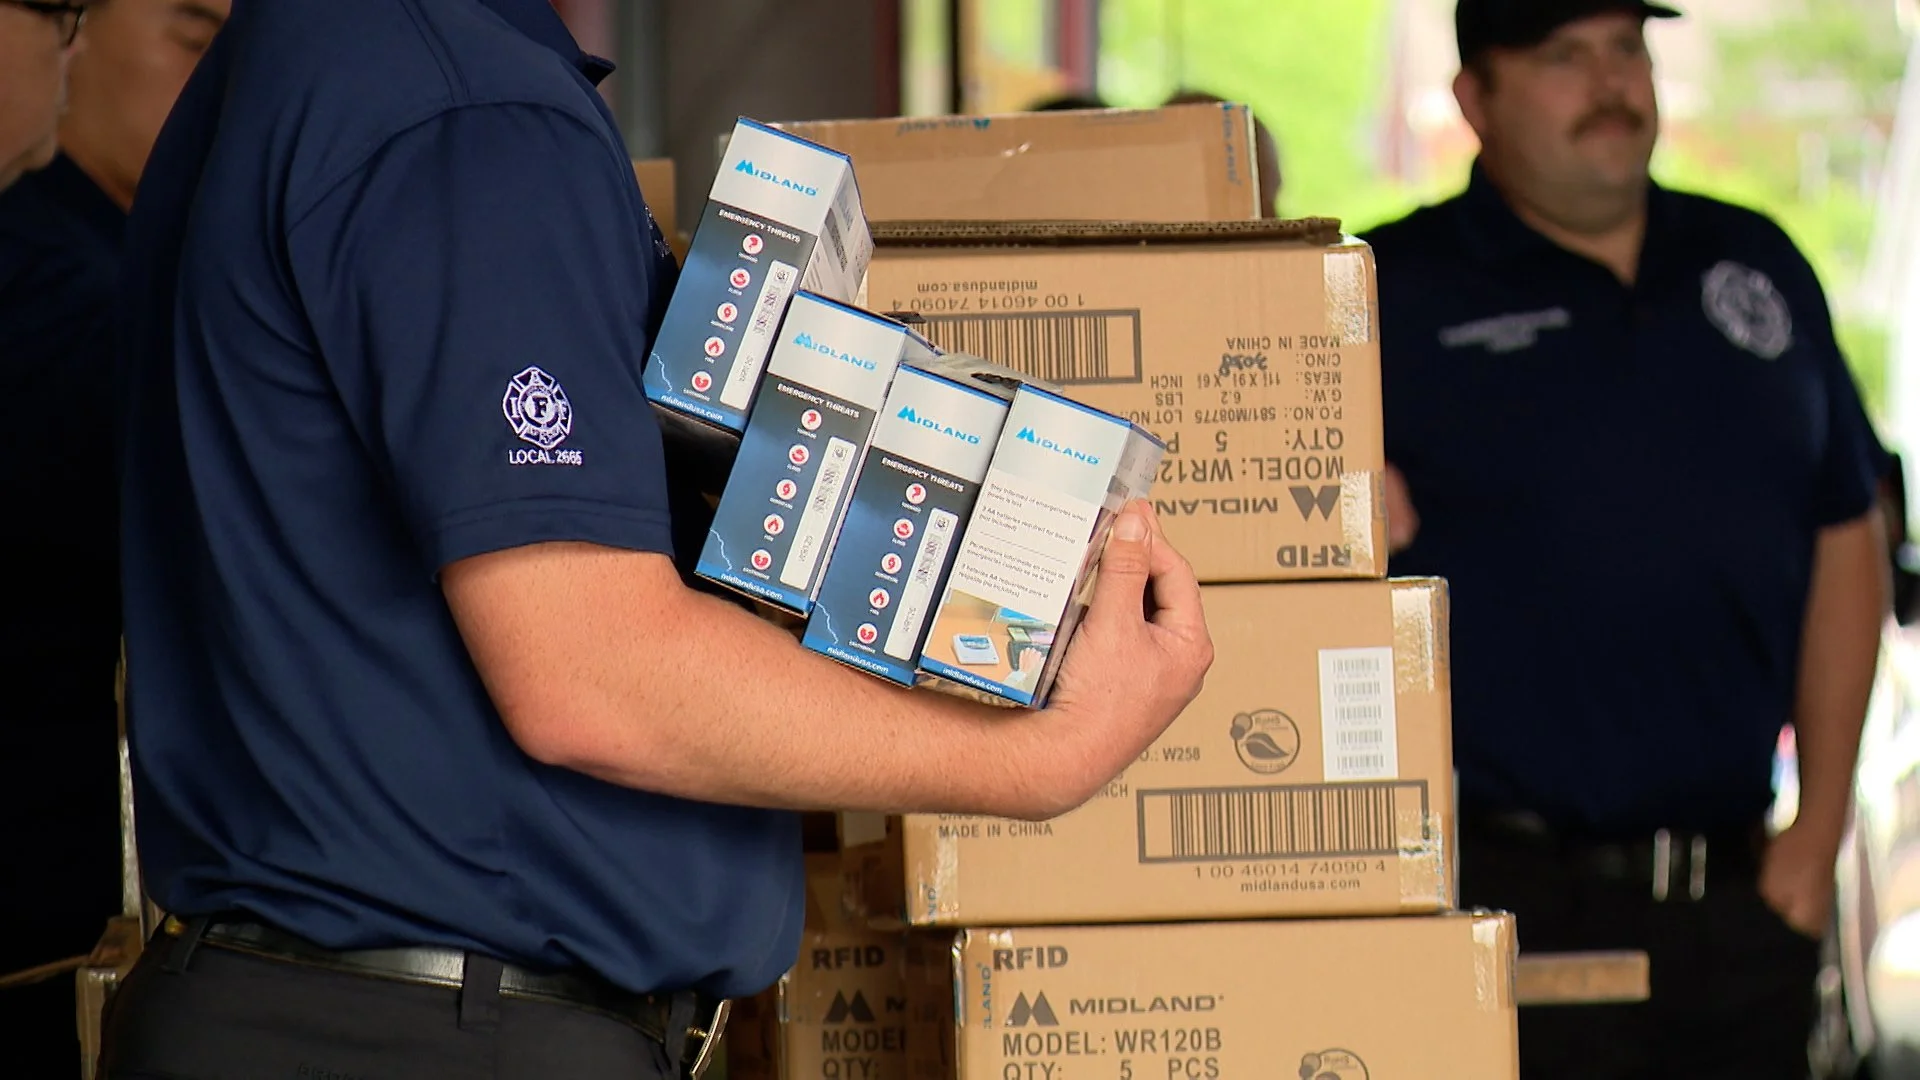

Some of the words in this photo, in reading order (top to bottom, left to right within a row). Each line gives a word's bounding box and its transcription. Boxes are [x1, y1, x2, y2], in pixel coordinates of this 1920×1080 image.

[735, 160, 817, 196] MIDLAND
[719, 209, 766, 229] EMERGENCY
[767, 225, 800, 244] THREATS
[918, 280, 1038, 294] midlandusa.com
[893, 299, 902, 311] 4
[910, 297, 970, 312] 74090
[979, 295, 1037, 309] 46014
[1045, 294, 1068, 308] 00
[1078, 295, 1085, 307] 1
[793, 332, 876, 371] MIDLAND
[1226, 337, 1271, 350] CHINA
[1279, 337, 1292, 349] IN
[1300, 336, 1340, 350] MADE
[1296, 353, 1341, 367] C/NO.:
[1151, 375, 1183, 388] INCH
[661, 394, 723, 421] midlandusa.com
[777, 383, 824, 405] EMERGENCY
[826, 401, 860, 419] THREATS
[1155, 392, 1183, 406] LBS
[1221, 391, 1241, 404] 6.2
[897, 406, 980, 444] MIDLAND
[1154, 409, 1183, 424] LOT
[1195, 408, 1276, 424] 581/M08775
[1016, 426, 1099, 465] MIDLAND
[1215, 431, 1228, 452] 5
[1285, 427, 1343, 450] QTY:
[508, 449, 555, 465] LOCAL
[882, 457, 929, 479] EMERGENCY
[930, 475, 964, 492] THREATS
[1154, 458, 1234, 482] WR12
[1242, 456, 1344, 481] MODEL:
[1151, 497, 1278, 515] MIDLAN
[1277, 545, 1351, 568] RFID
[720, 573, 783, 600] midlandusa.com
[827, 647, 889, 674] midlandusa.com
[943, 667, 1003, 694] midlandusa.com
[939, 824, 979, 838] MADE
[987, 824, 1001, 838] IN
[1008, 823, 1053, 837] CHINA
[1195, 866, 1201, 879] 1
[1210, 865, 1234, 878] 00
[1240, 862, 1300, 877] 46014
[1309, 860, 1367, 875] 74090
[1375, 859, 1385, 872] 4
[1240, 878, 1360, 893] midlandusa.com
[812, 946, 884, 970] RFID
[993, 945, 1069, 971] RFID
[1069, 995, 1216, 1016] MIDLAND
[1002, 1030, 1106, 1058] MODEL:
[1115, 1027, 1222, 1054] WR120B
[1003, 1061, 1063, 1080] QTY:
[1120, 1059, 1133, 1080] 5
[1168, 1057, 1221, 1080] PCS
